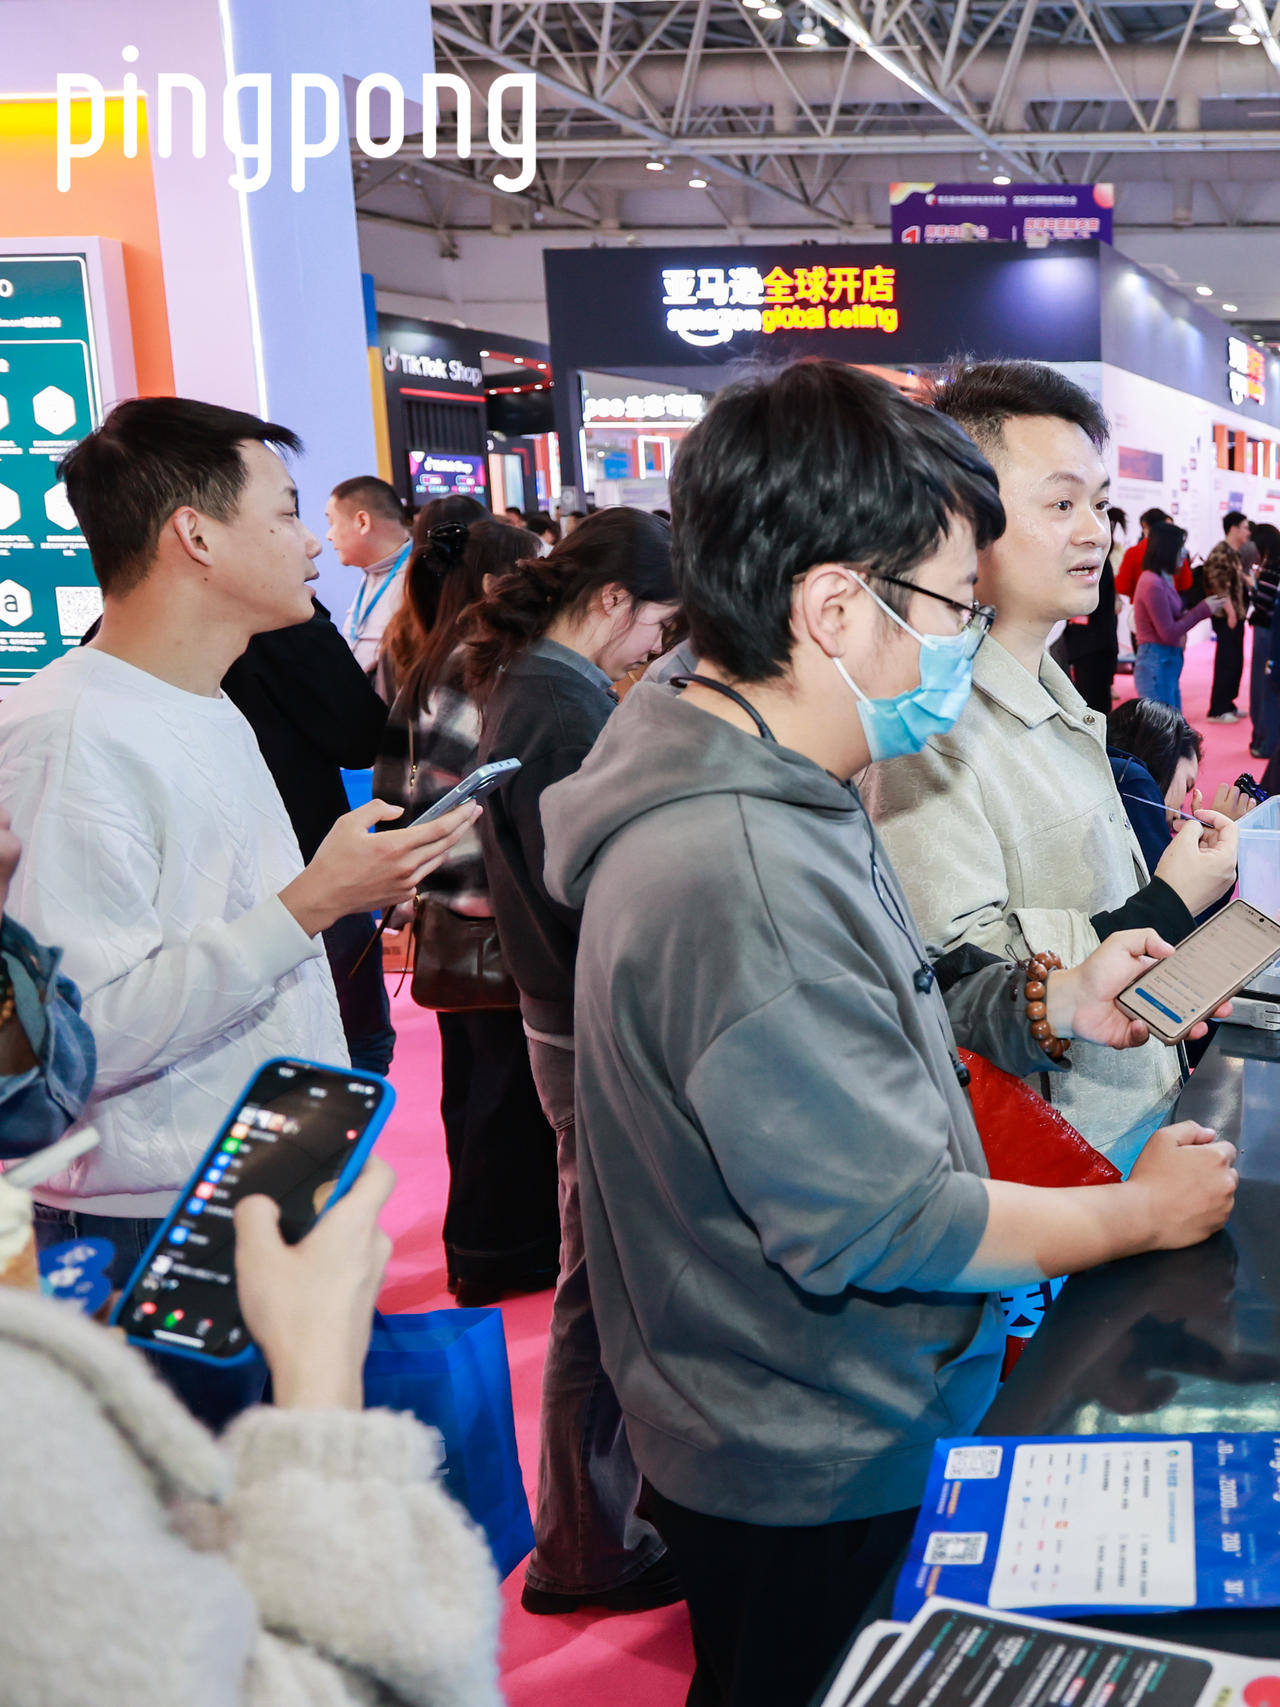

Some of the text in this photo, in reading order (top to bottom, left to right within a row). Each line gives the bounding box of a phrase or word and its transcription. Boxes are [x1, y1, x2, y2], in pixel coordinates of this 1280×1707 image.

[661, 264, 897, 305] 亚马逊全球开店
[762, 304, 826, 333] global
[828, 304, 898, 333] selling
[401, 354, 483, 387] TikTok Shop
